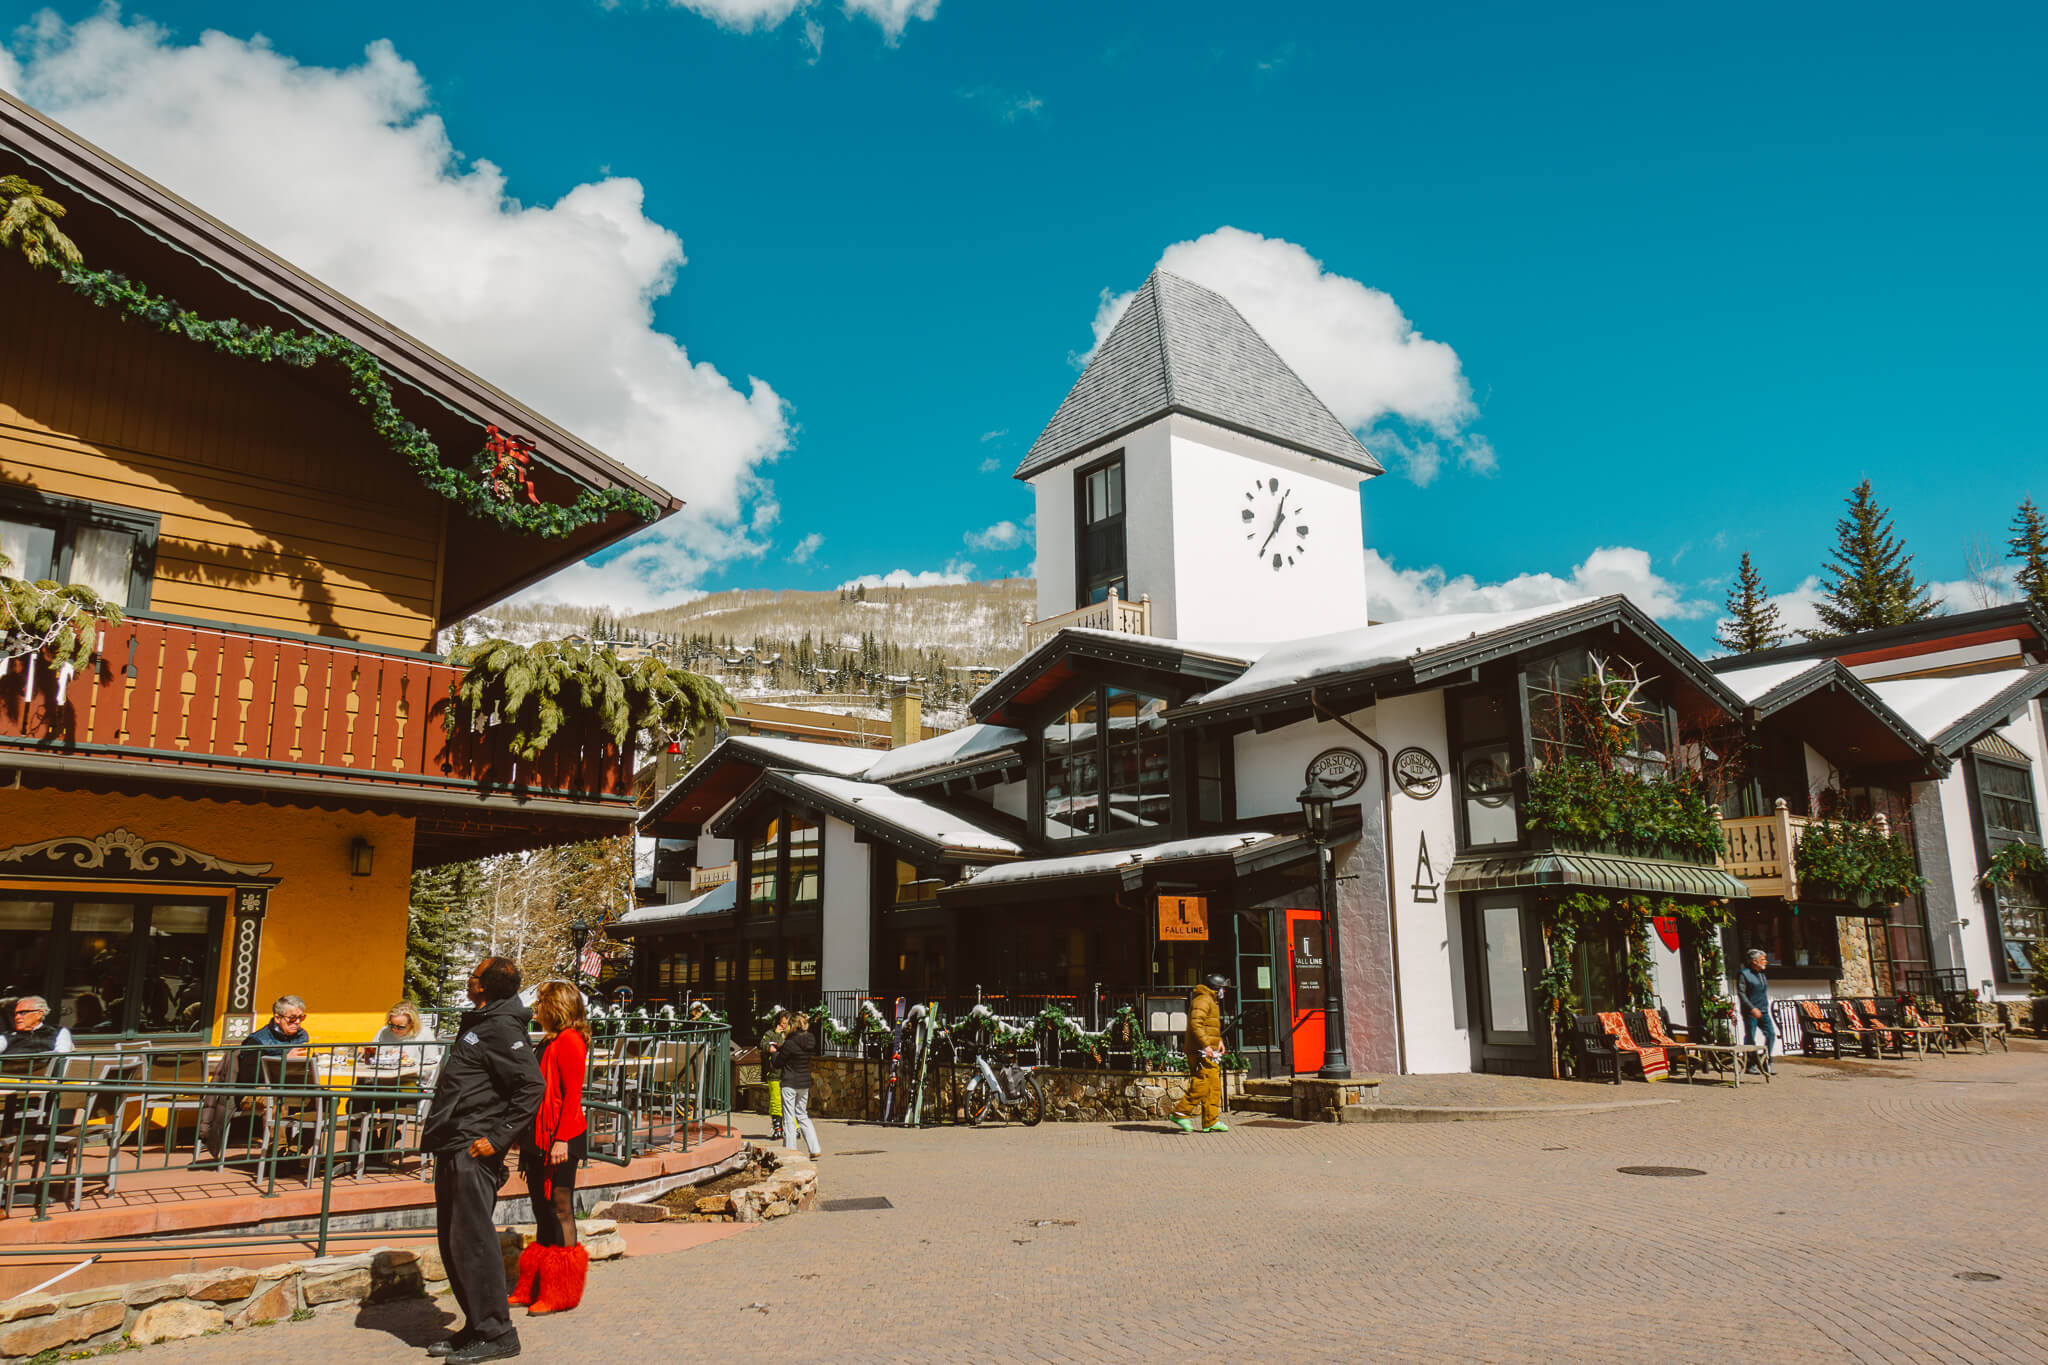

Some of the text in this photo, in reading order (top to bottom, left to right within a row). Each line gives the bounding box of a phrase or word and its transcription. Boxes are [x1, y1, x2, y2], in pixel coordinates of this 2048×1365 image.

[1400, 753, 1435, 773] GORSUCH
[1329, 766, 1344, 775] LTD
[1410, 765, 1424, 774] LTD
[1165, 926, 1203, 934] FALL LINE
